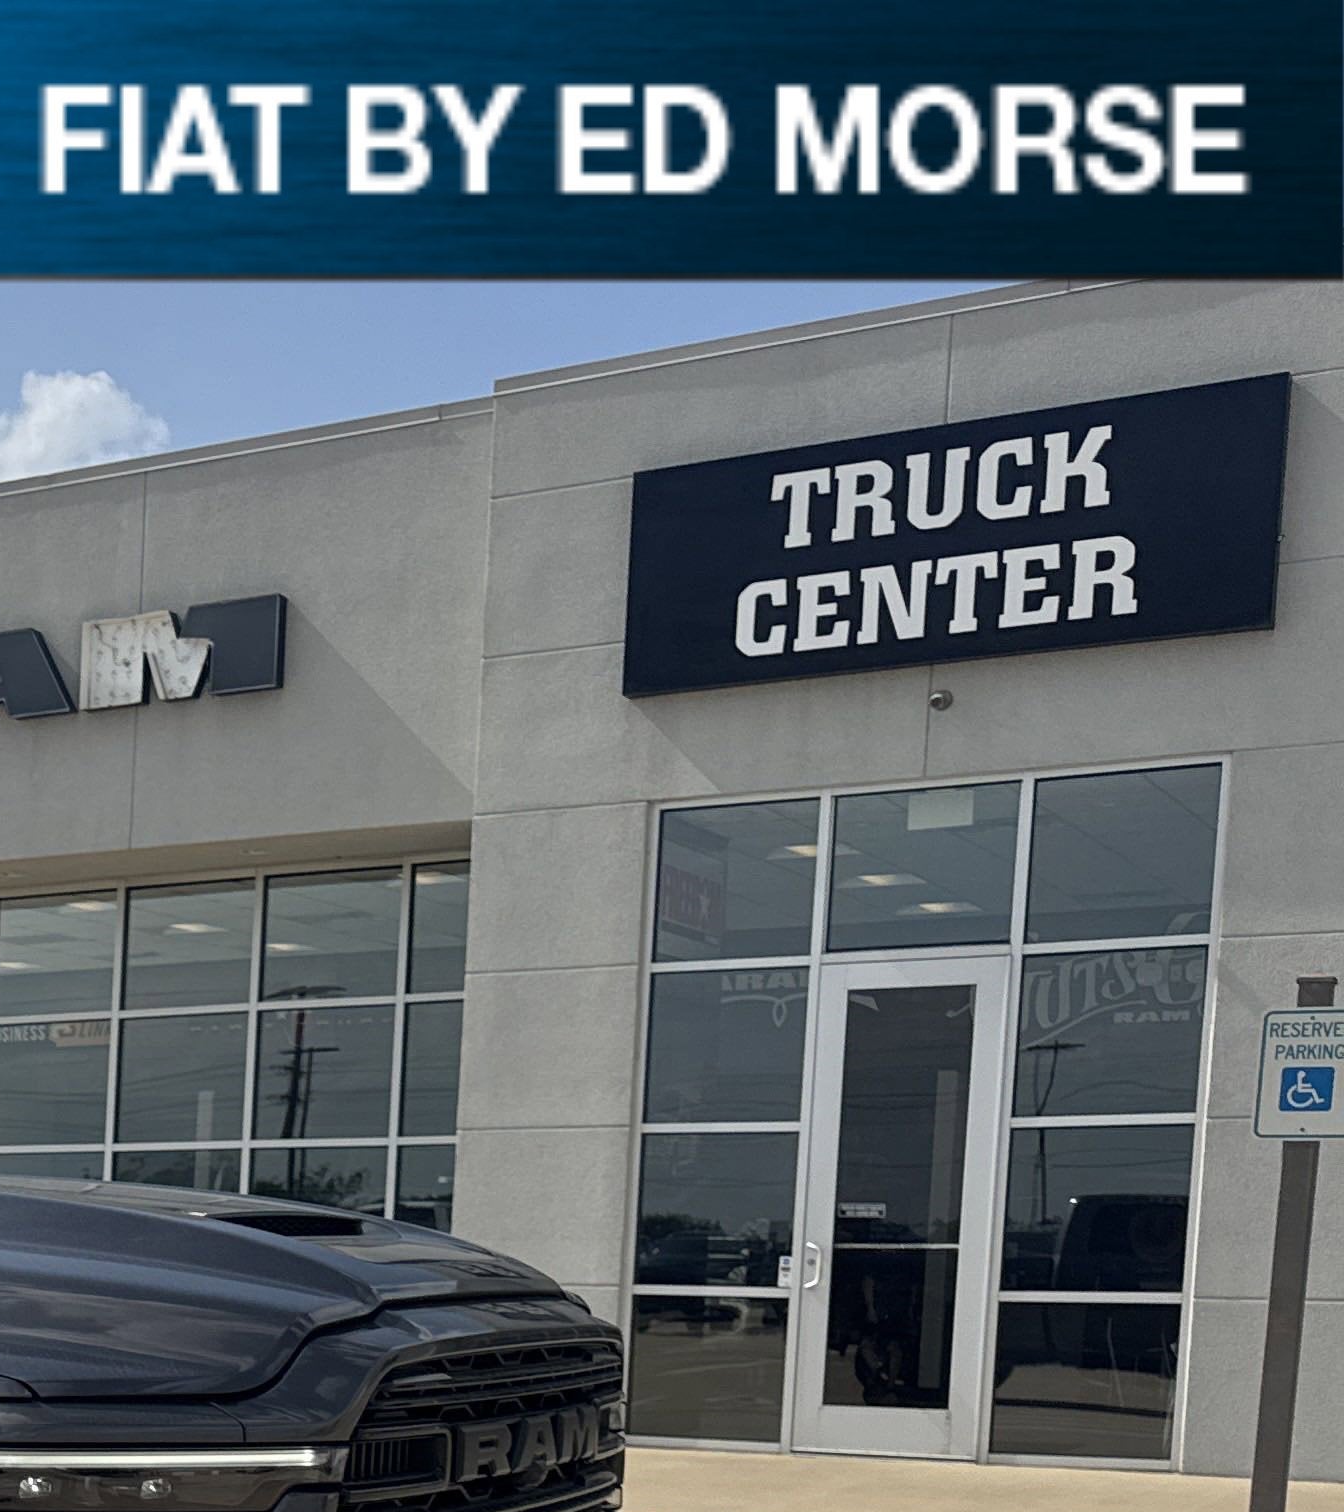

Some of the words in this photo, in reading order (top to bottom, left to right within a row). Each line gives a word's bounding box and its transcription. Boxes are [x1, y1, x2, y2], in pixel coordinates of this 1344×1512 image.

[771, 425, 1112, 549] TRUCK
[735, 536, 1138, 657] CENTER
[1113, 1010, 1192, 1025] RAM
[1269, 1021, 1344, 1038] RESERVE
[1274, 1043, 1344, 1060] PARKING
[456, 1402, 601, 1482] RAM
